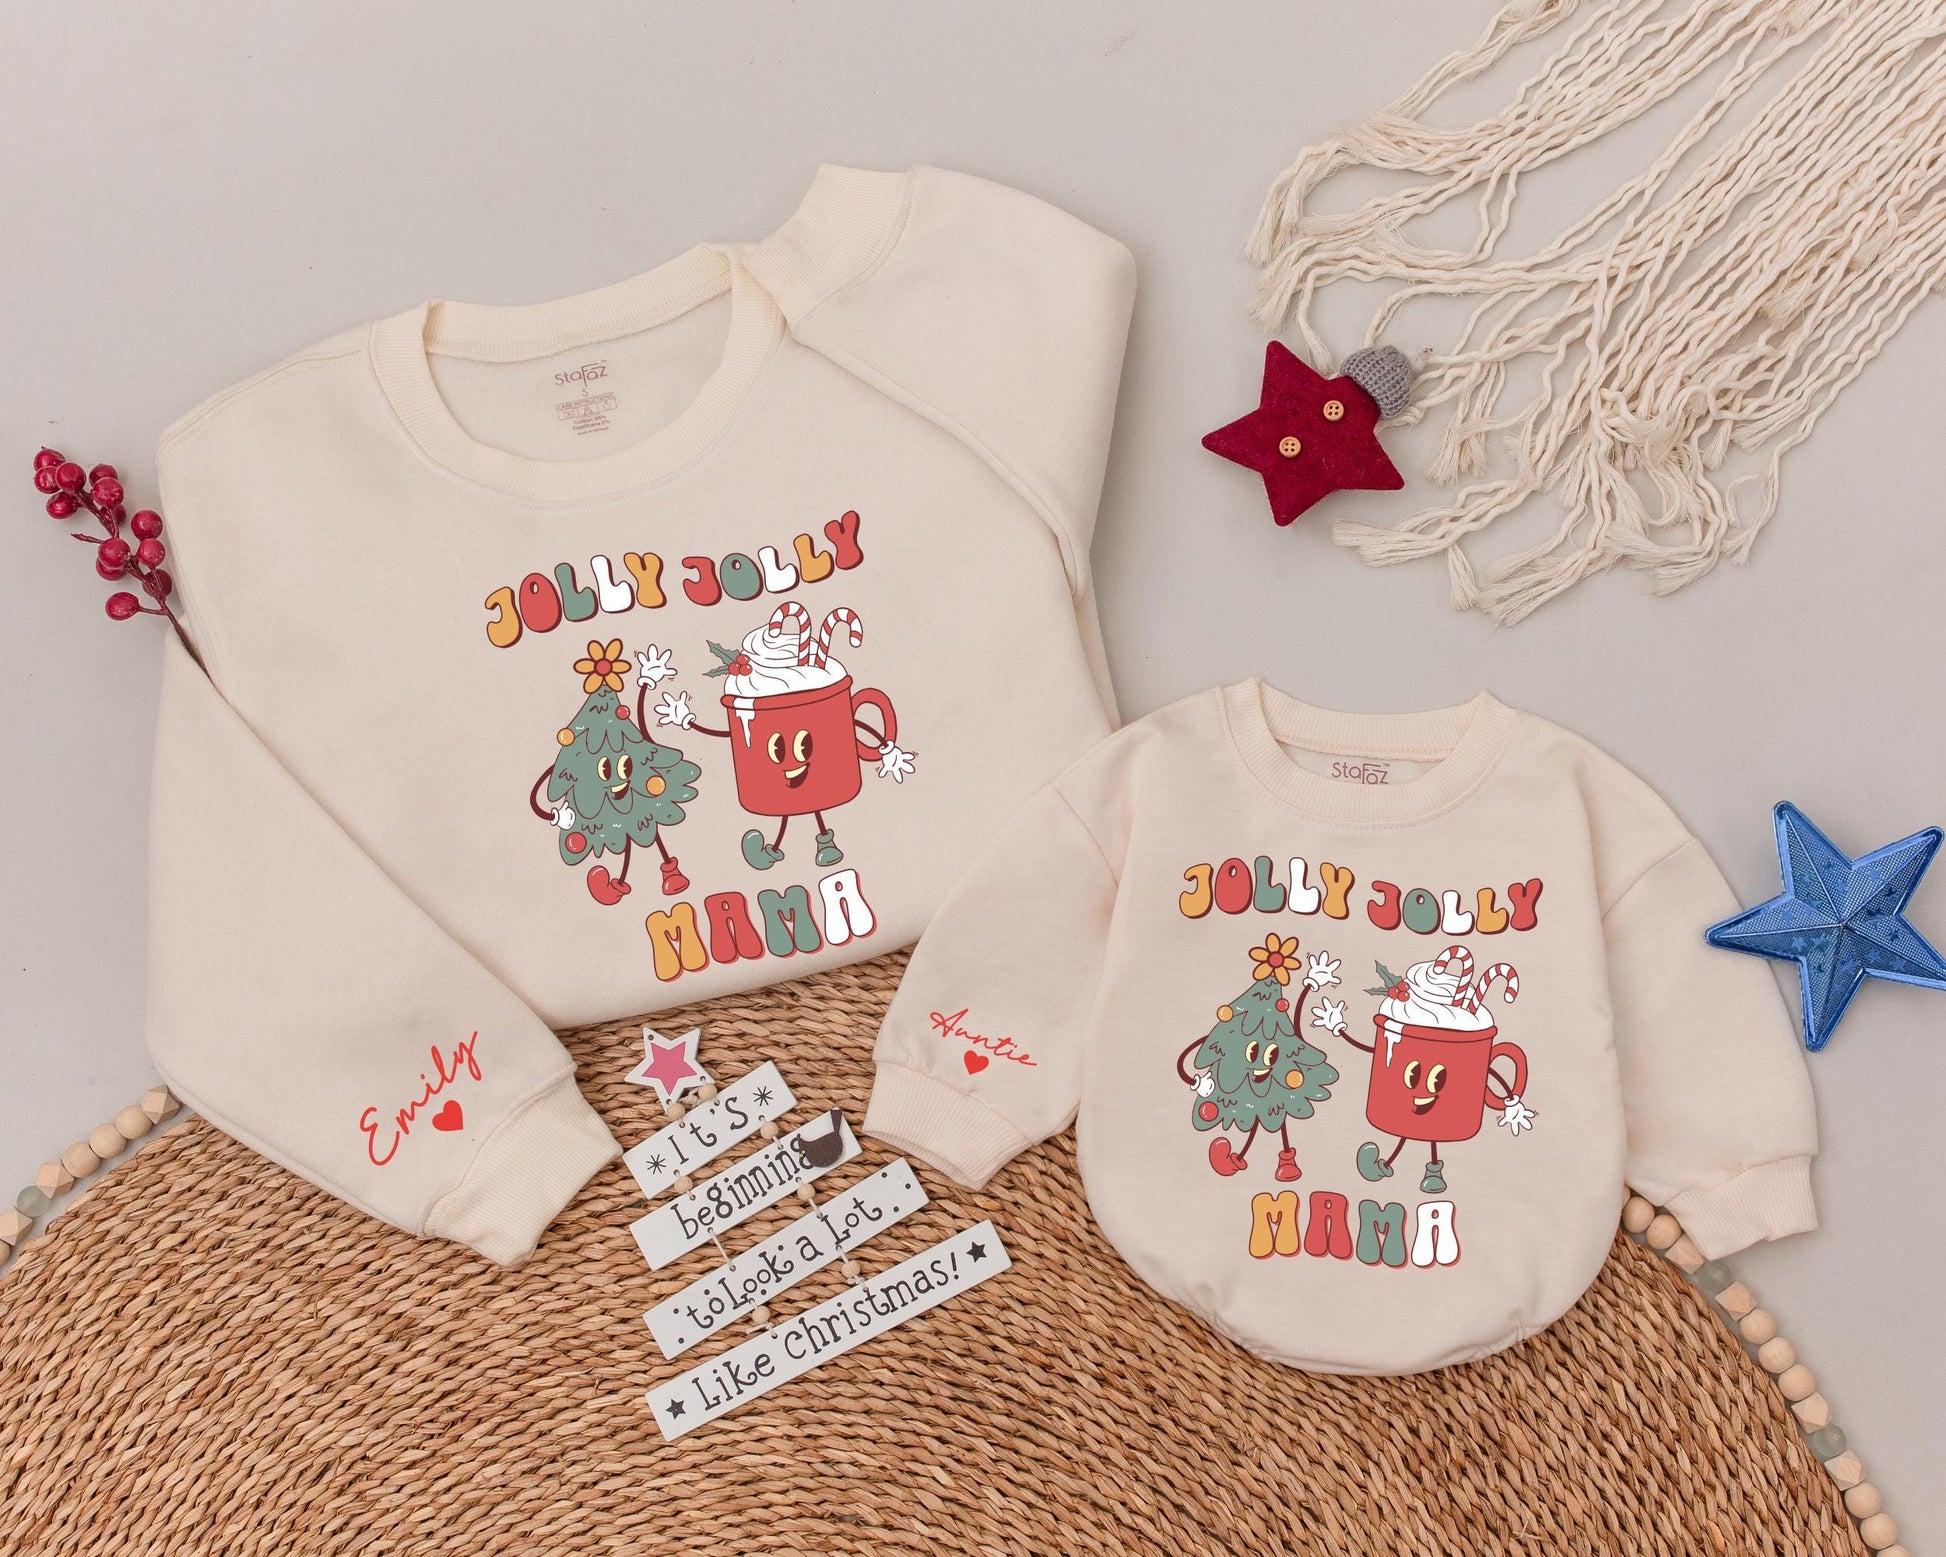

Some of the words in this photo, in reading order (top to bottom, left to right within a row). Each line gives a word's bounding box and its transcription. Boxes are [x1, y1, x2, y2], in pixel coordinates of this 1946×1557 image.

[485, 552, 667, 648] JOLLY
[682, 510, 864, 606] JOLLY
[645, 868, 876, 982] MAMA
[1179, 856, 1355, 919] JOLLY
[1367, 878, 1544, 936] JOLLY
[929, 1008, 1037, 1067] Auntie
[359, 1030, 482, 1166] Emily
[799, 1235, 823, 1261] a
[1248, 1190, 1462, 1268] MAMA
